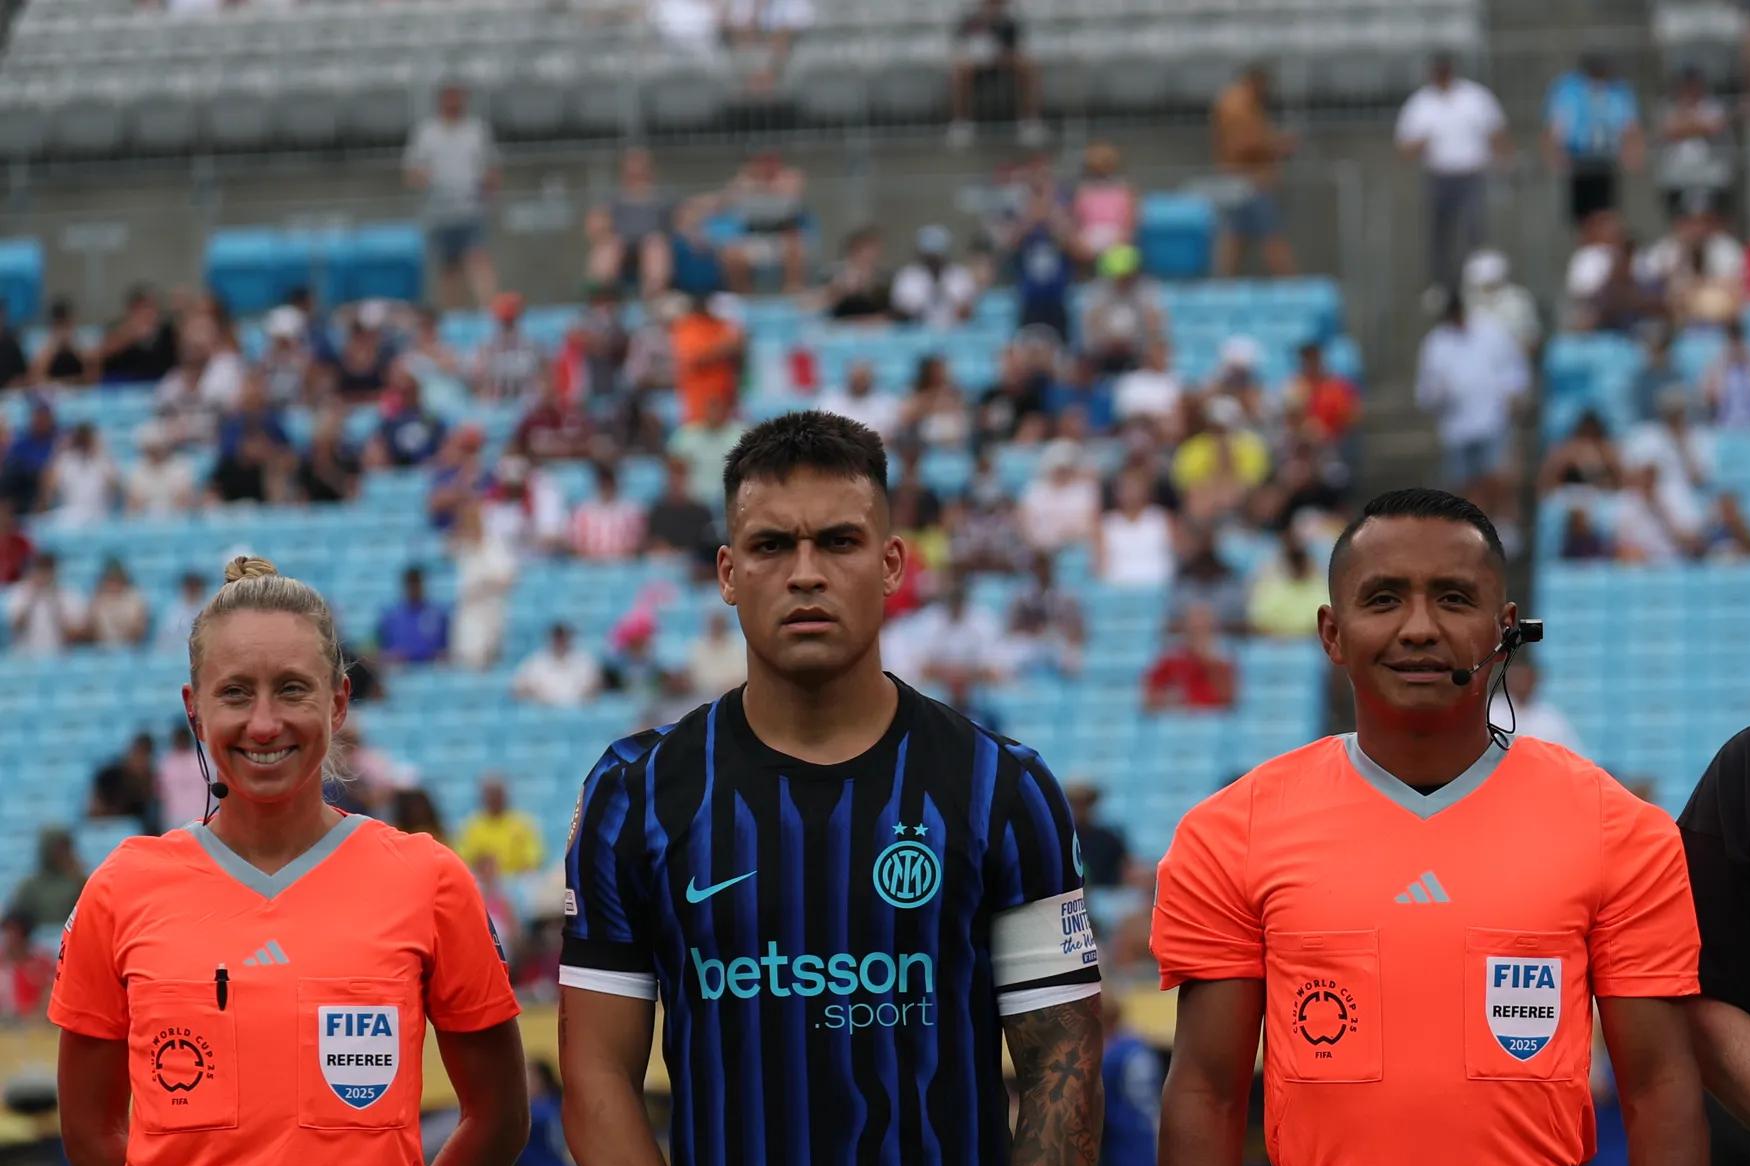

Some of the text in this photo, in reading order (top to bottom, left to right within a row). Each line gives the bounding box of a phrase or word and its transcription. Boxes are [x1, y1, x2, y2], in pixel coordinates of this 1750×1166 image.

[690, 941, 934, 1000] betsson
[1494, 964, 1556, 989] FIFA
[814, 996, 935, 1035] .sport
[1296, 979, 1336, 998] WORLD
[1340, 988, 1357, 1010] CUP
[1349, 1017, 1358, 1033] 25
[1492, 1005, 1555, 1019] REFEREE
[326, 1013, 393, 1037] FIFA
[153, 1027, 191, 1046] WORLD
[195, 1035, 213, 1058] CUP
[206, 1064, 215, 1080] 25
[1509, 1039, 1538, 1051] 2025
[326, 1054, 393, 1066] REFEREE
[1315, 1051, 1332, 1059] FIFA
[171, 1098, 188, 1106] FIFA
[345, 1087, 375, 1099] 2025
